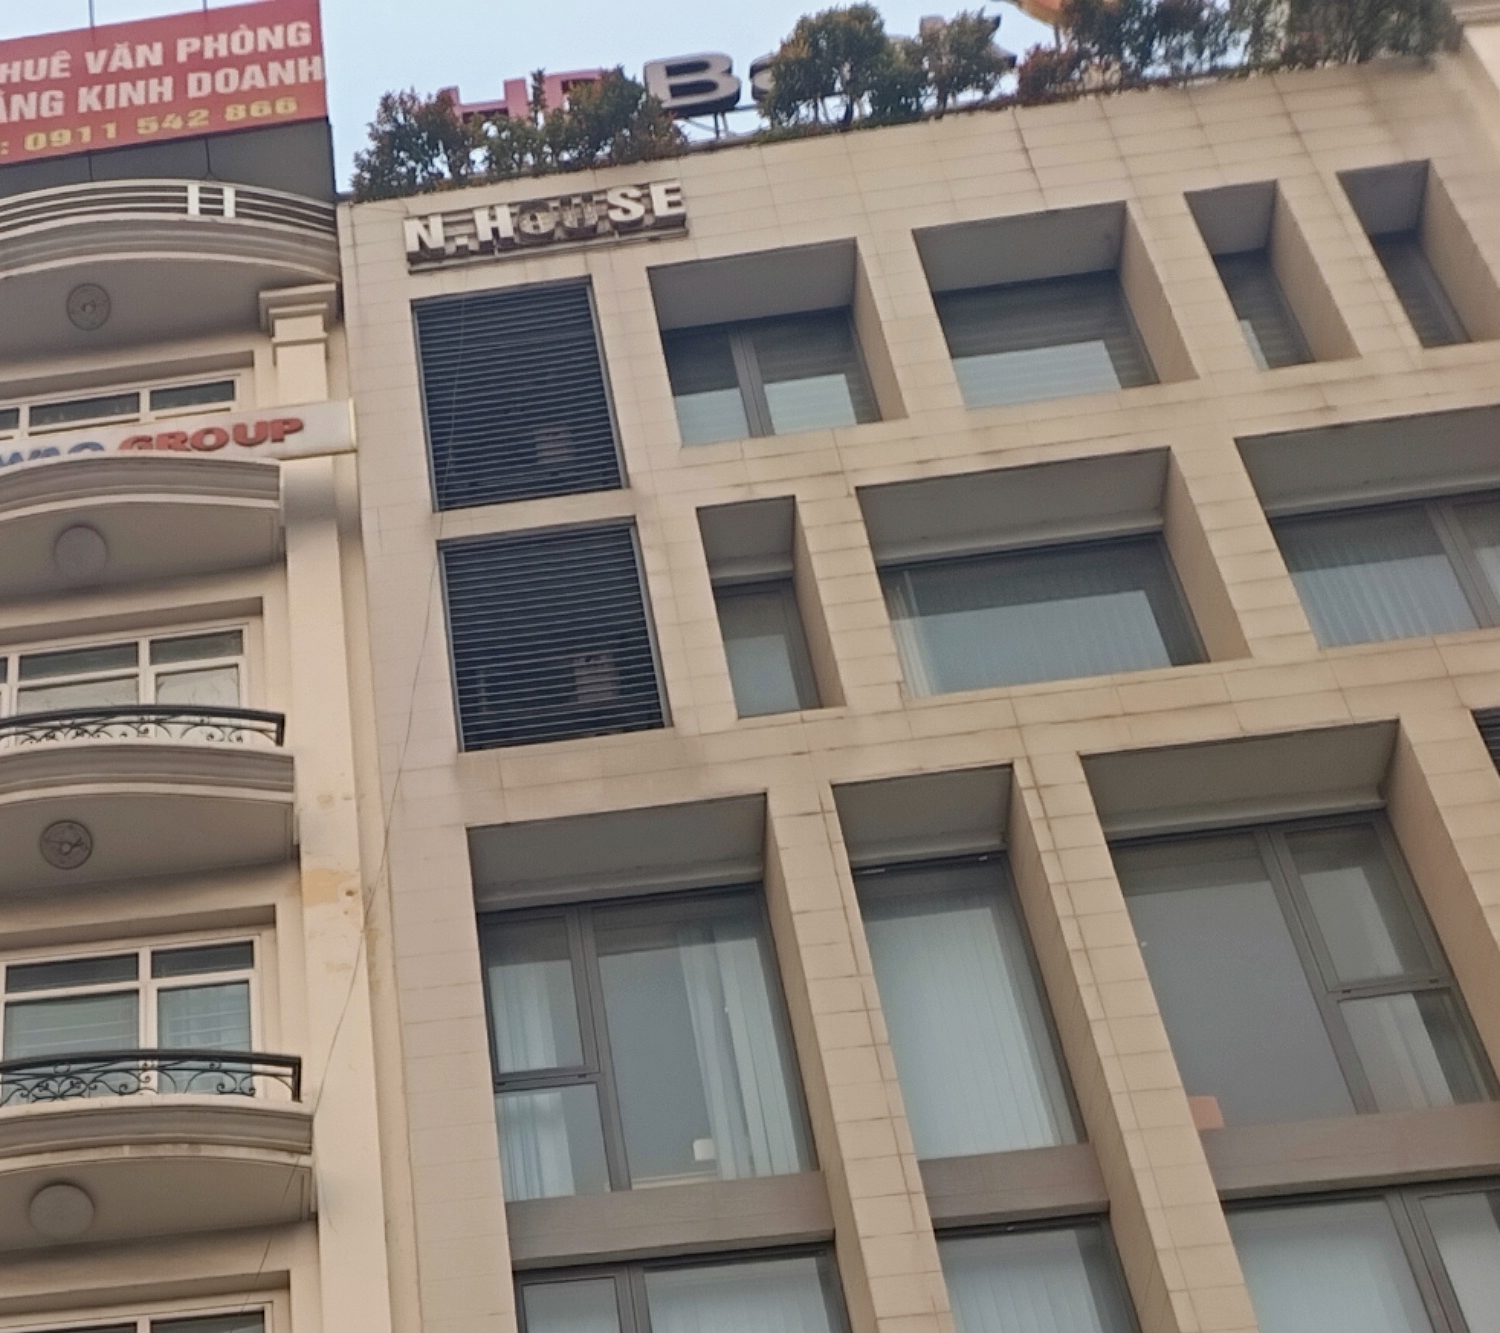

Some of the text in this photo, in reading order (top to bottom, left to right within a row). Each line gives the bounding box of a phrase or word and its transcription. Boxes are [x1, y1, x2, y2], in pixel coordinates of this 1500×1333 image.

[84, 41, 164, 74] VĂN
[176, 20, 312, 63] PHÒNG
[77, 75, 174, 113] KINH
[186, 54, 324, 99] DOANH
[24, 121, 118, 152] 0911
[136, 108, 211, 135] 542
[224, 96, 299, 122] 866
[118, 417, 304, 453] GROUP
